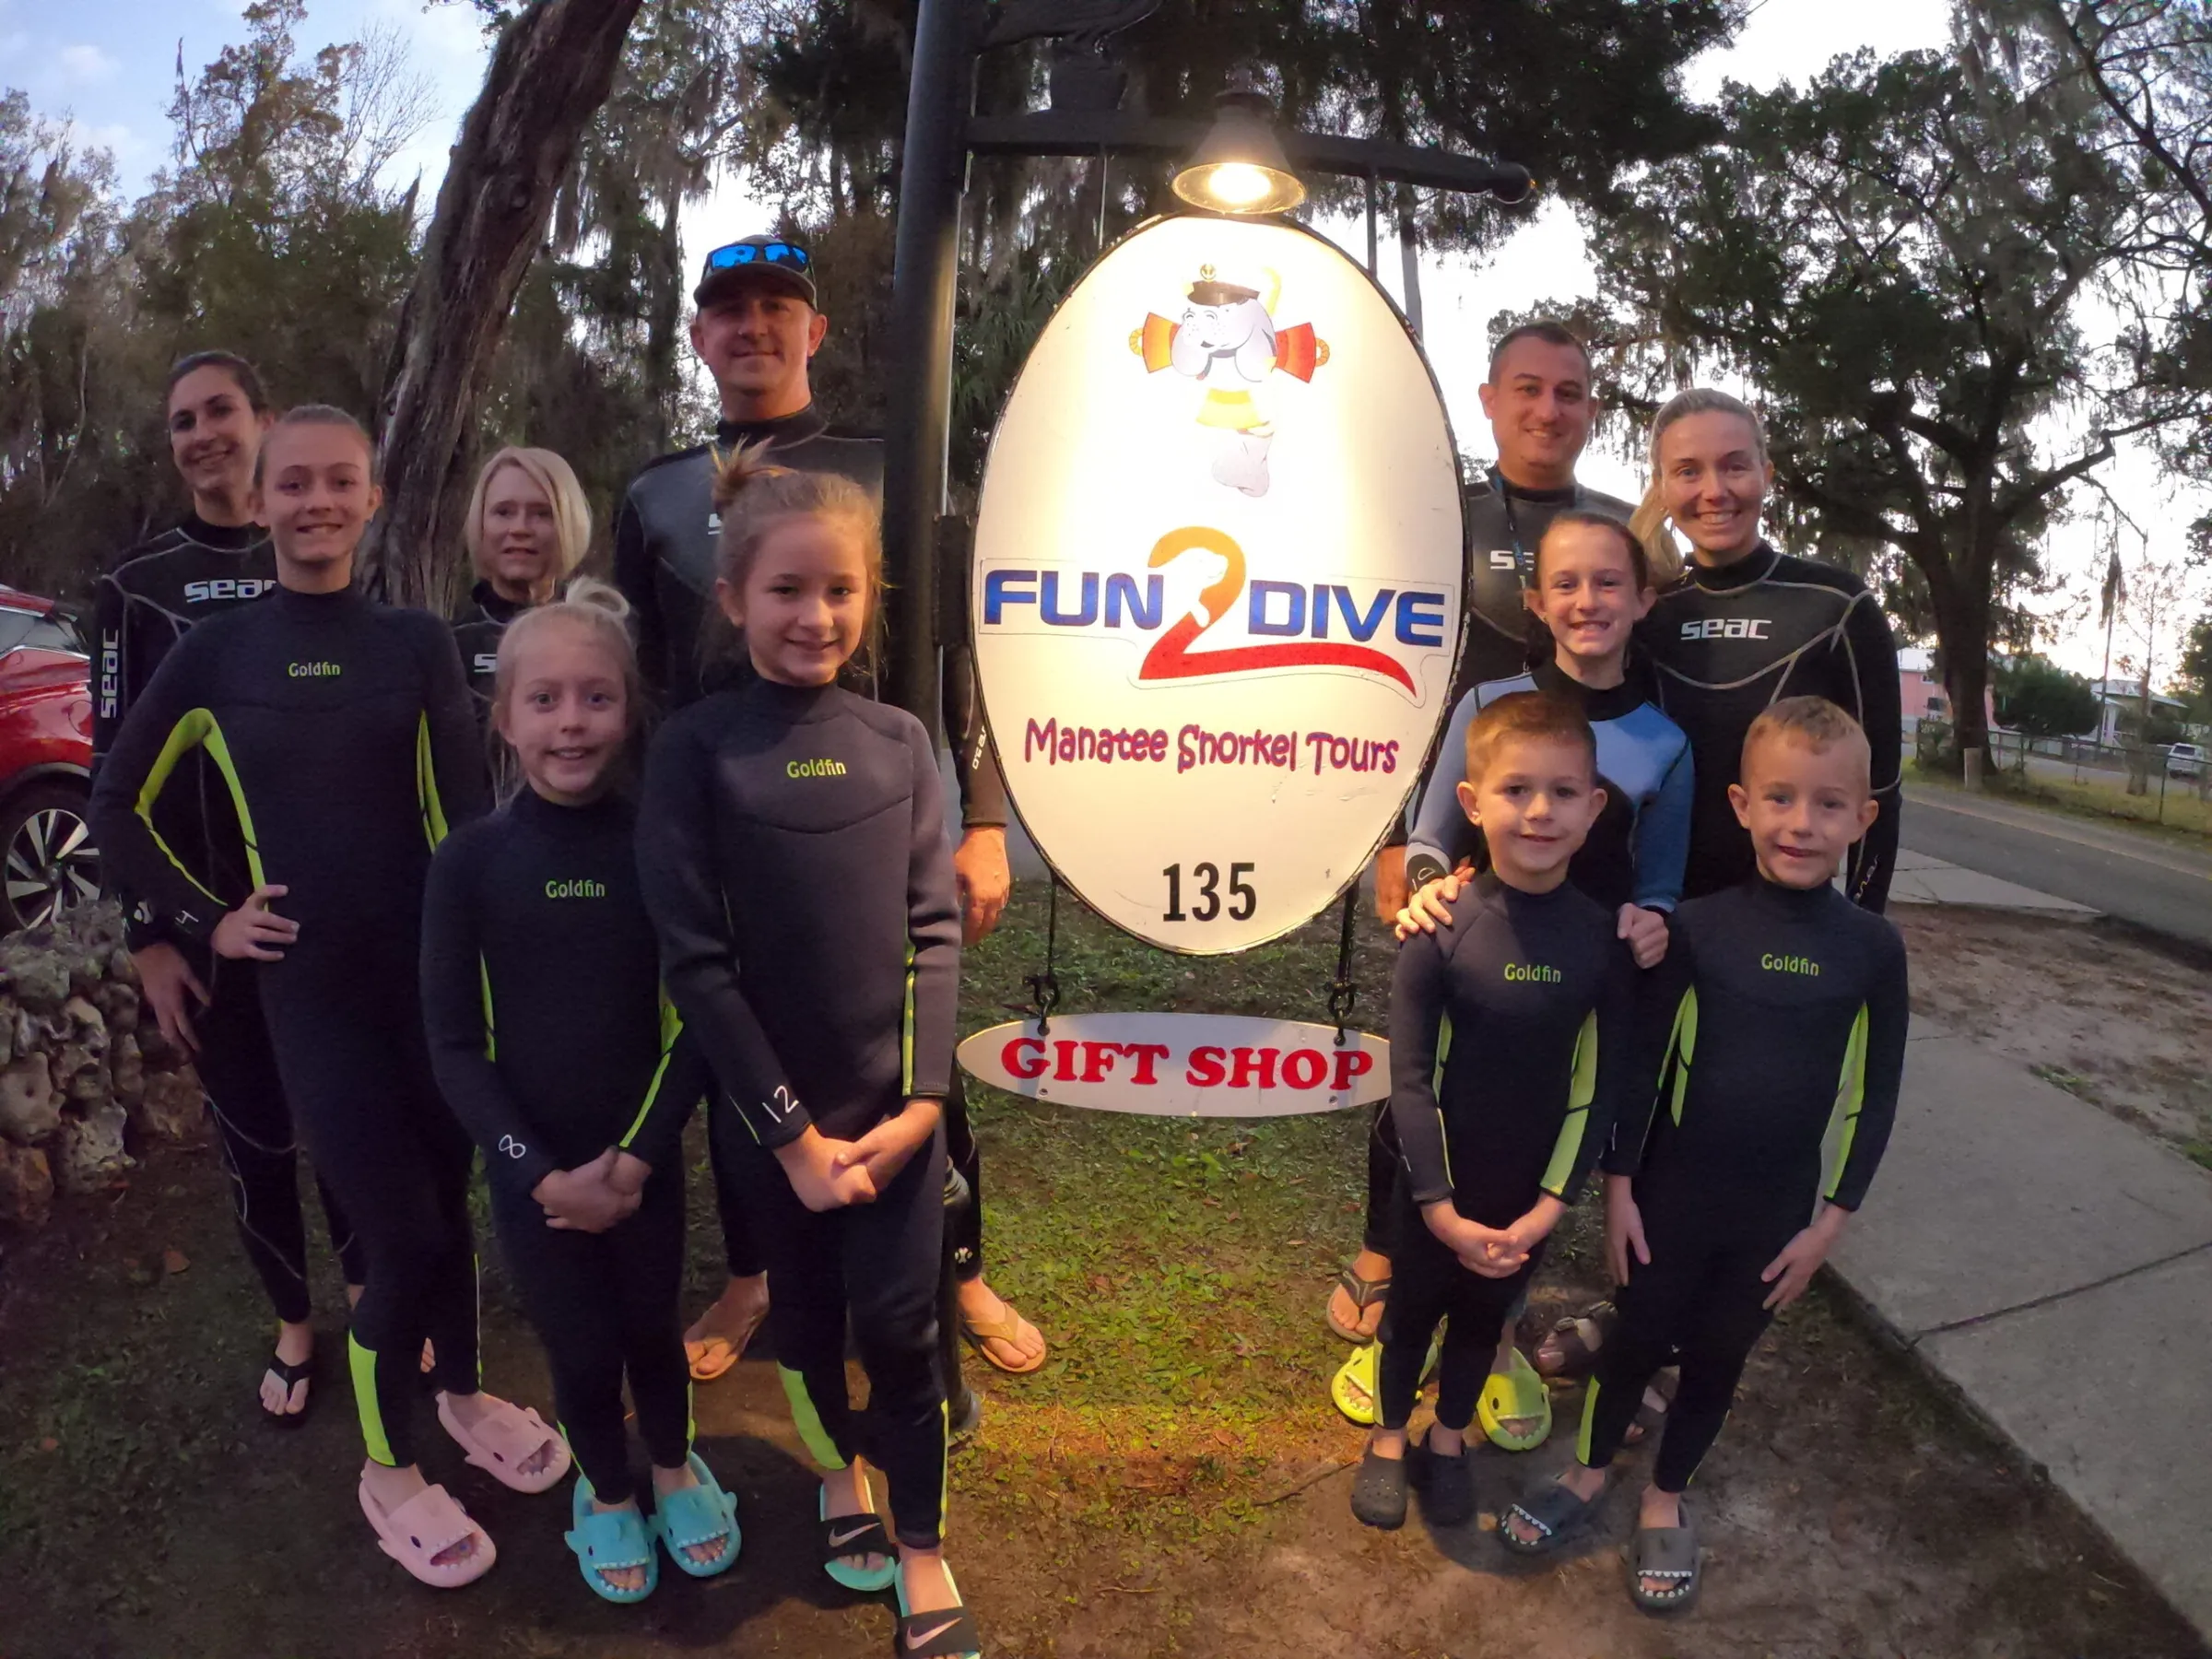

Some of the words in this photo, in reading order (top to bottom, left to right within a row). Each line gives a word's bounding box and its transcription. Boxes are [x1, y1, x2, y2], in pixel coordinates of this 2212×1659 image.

[288, 661, 341, 677] Goldfin
[1024, 716, 1169, 767] Manatee
[1177, 724, 1298, 774] Snorkel
[1305, 731, 1400, 776] Tours
[786, 758, 847, 779] Goldfin
[545, 878, 606, 899] Goldfin
[1162, 862, 1257, 923] 135
[1504, 962, 1562, 983] Goldfin
[1760, 953, 1820, 977] Goldfin
[1001, 1037, 1170, 1087] GIFT
[1185, 1045, 1374, 1091] SHOP
[761, 1085, 800, 1124] 12
